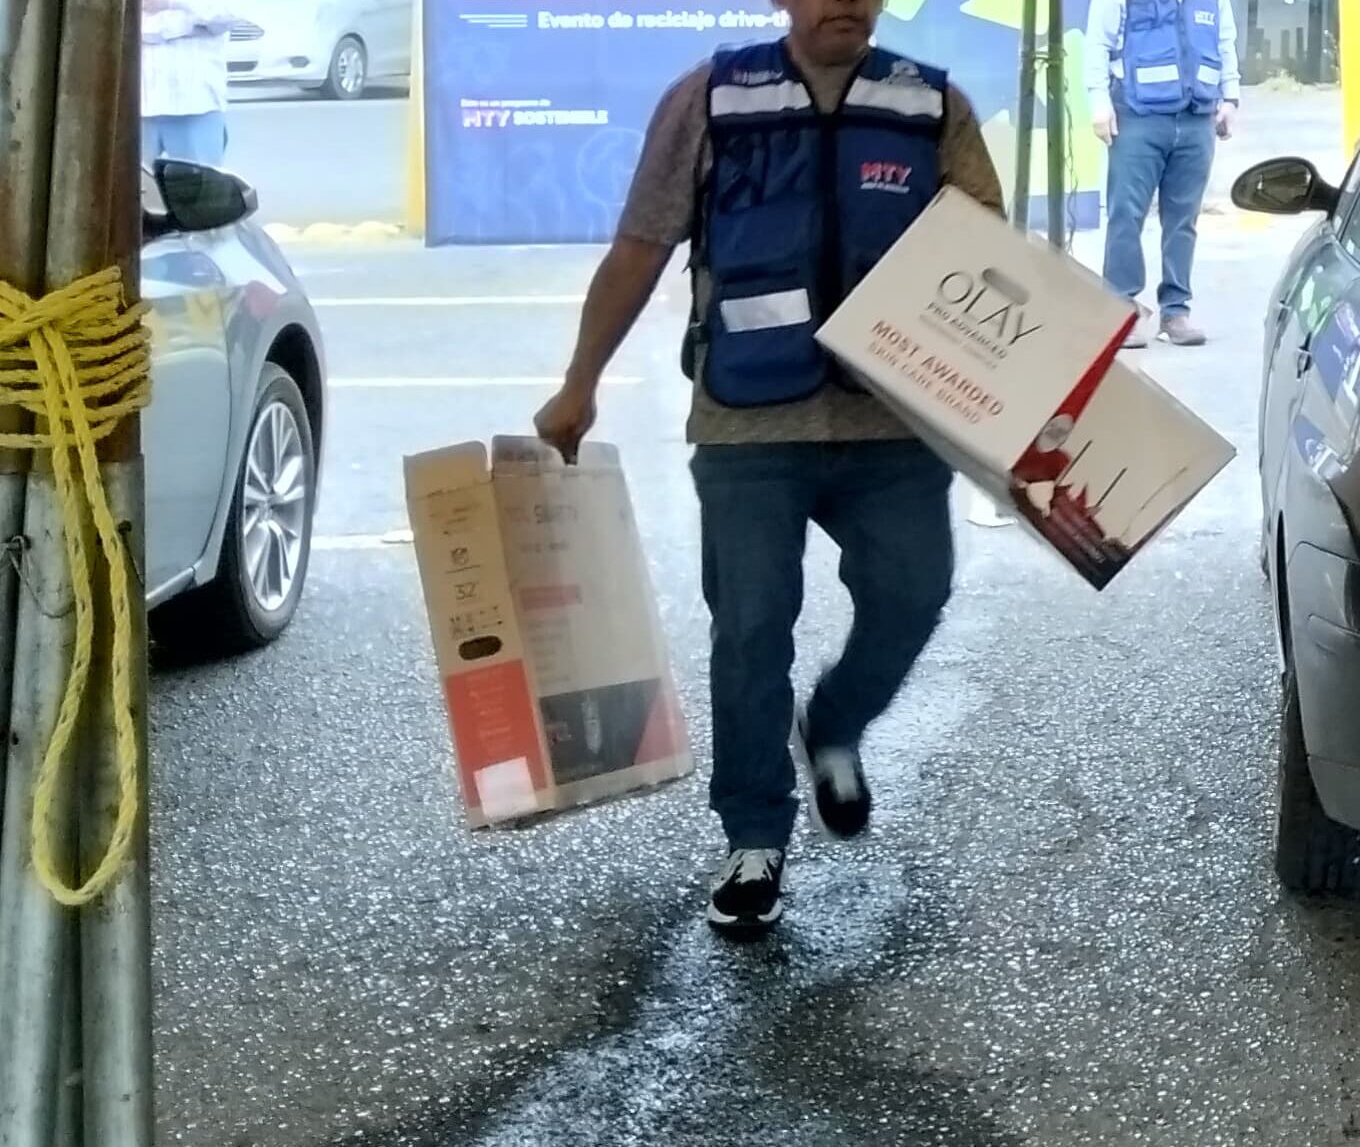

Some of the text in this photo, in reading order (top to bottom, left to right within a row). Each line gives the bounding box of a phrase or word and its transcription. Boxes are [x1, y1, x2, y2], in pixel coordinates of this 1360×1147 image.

[537, 11, 605, 29] Evento
[607, 11, 634, 29] de
[636, 10, 717, 31] reciclaje
[860, 161, 912, 185] MTY
[937, 270, 1043, 347] OLAY
[871, 319, 921, 358] MOST
[920, 354, 1005, 417] AWARDED
